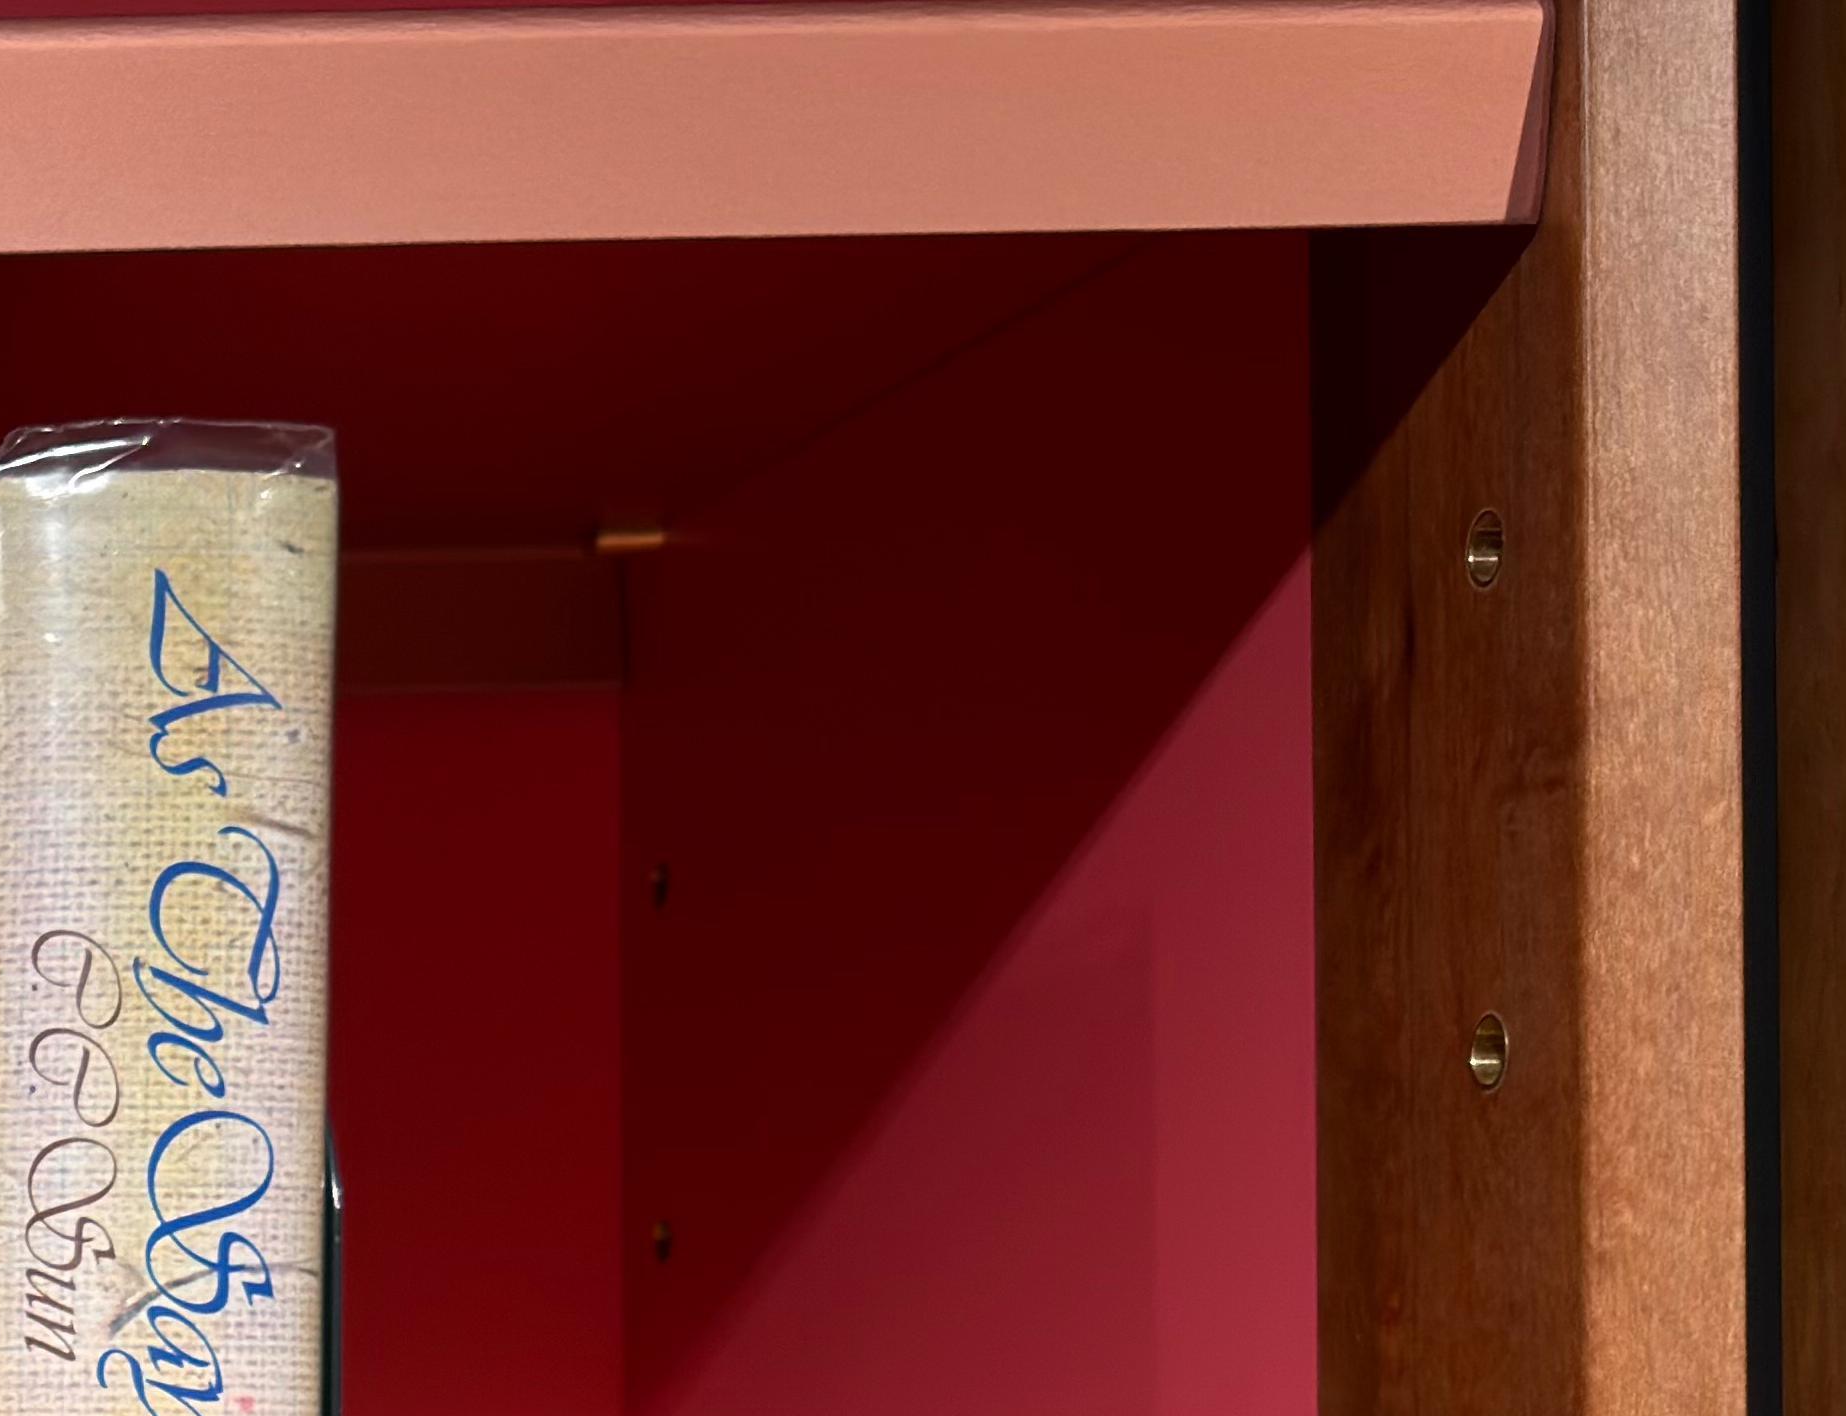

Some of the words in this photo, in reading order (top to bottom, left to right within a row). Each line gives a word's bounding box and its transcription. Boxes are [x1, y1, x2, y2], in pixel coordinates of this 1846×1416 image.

[146, 565, 282, 798] As
[131, 824, 281, 1099] The
[23, 1136, 119, 1363] Sun
